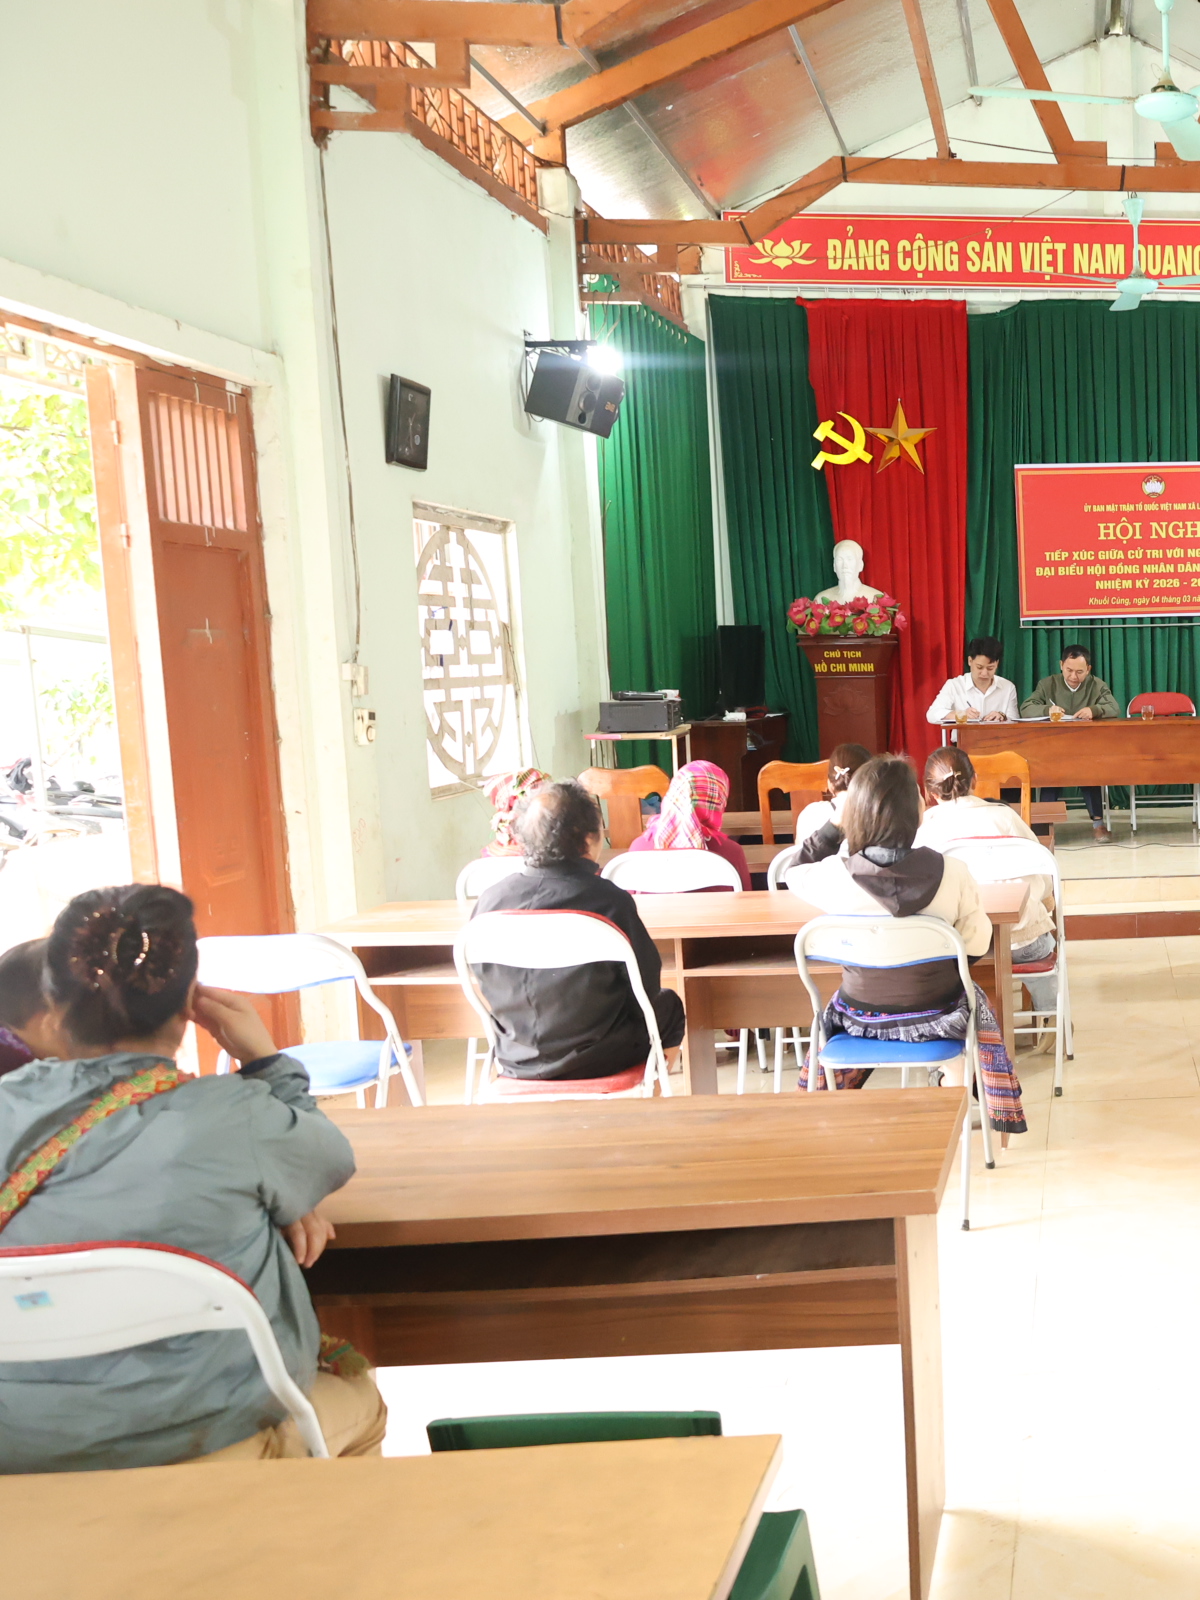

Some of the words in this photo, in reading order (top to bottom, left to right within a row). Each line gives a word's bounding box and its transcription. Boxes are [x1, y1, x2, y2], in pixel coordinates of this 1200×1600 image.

[827, 225, 890, 271] ĐẢNG
[897, 233, 959, 278] CỘNG
[966, 228, 1013, 273] SẢN
[1019, 236, 1067, 280] VIỆT
[1073, 243, 1125, 275] NAM
[1106, 503, 1118, 513] MẶT
[1119, 503, 1135, 513] TRẬN
[1144, 501, 1159, 511] QUỐC
[1160, 502, 1172, 512] VIỆT
[1188, 502, 1196, 510] XÃ
[1097, 517, 1143, 544] HỘI
[1044, 549, 1069, 561] TIẾP
[1072, 549, 1095, 560] XÚC
[1098, 549, 1125, 560] GIỮA
[1127, 547, 1144, 559] CỬ
[1146, 549, 1163, 559] TRI
[1166, 547, 1184, 558] VỚI
[1035, 566, 1055, 578] ĐẠI
[1058, 562, 1084, 575] BIỂU
[1087, 564, 1106, 577] HỘI
[1109, 562, 1140, 575] ĐỒNG
[1143, 562, 1174, 574] NHÂN
[1177, 562, 1200, 573] DÂN
[1095, 578, 1132, 591] NHIỆM
[1153, 578, 1180, 588] 2026
[1133, 595, 1150, 606] ngày
[1151, 596, 1160, 604] 04
[1161, 595, 1181, 605] tháng
[1182, 595, 1191, 603] 03
[843, 651, 862, 659] TỊCH
[814, 659, 828, 672] HỒ
[849, 663, 875, 672] MINH
